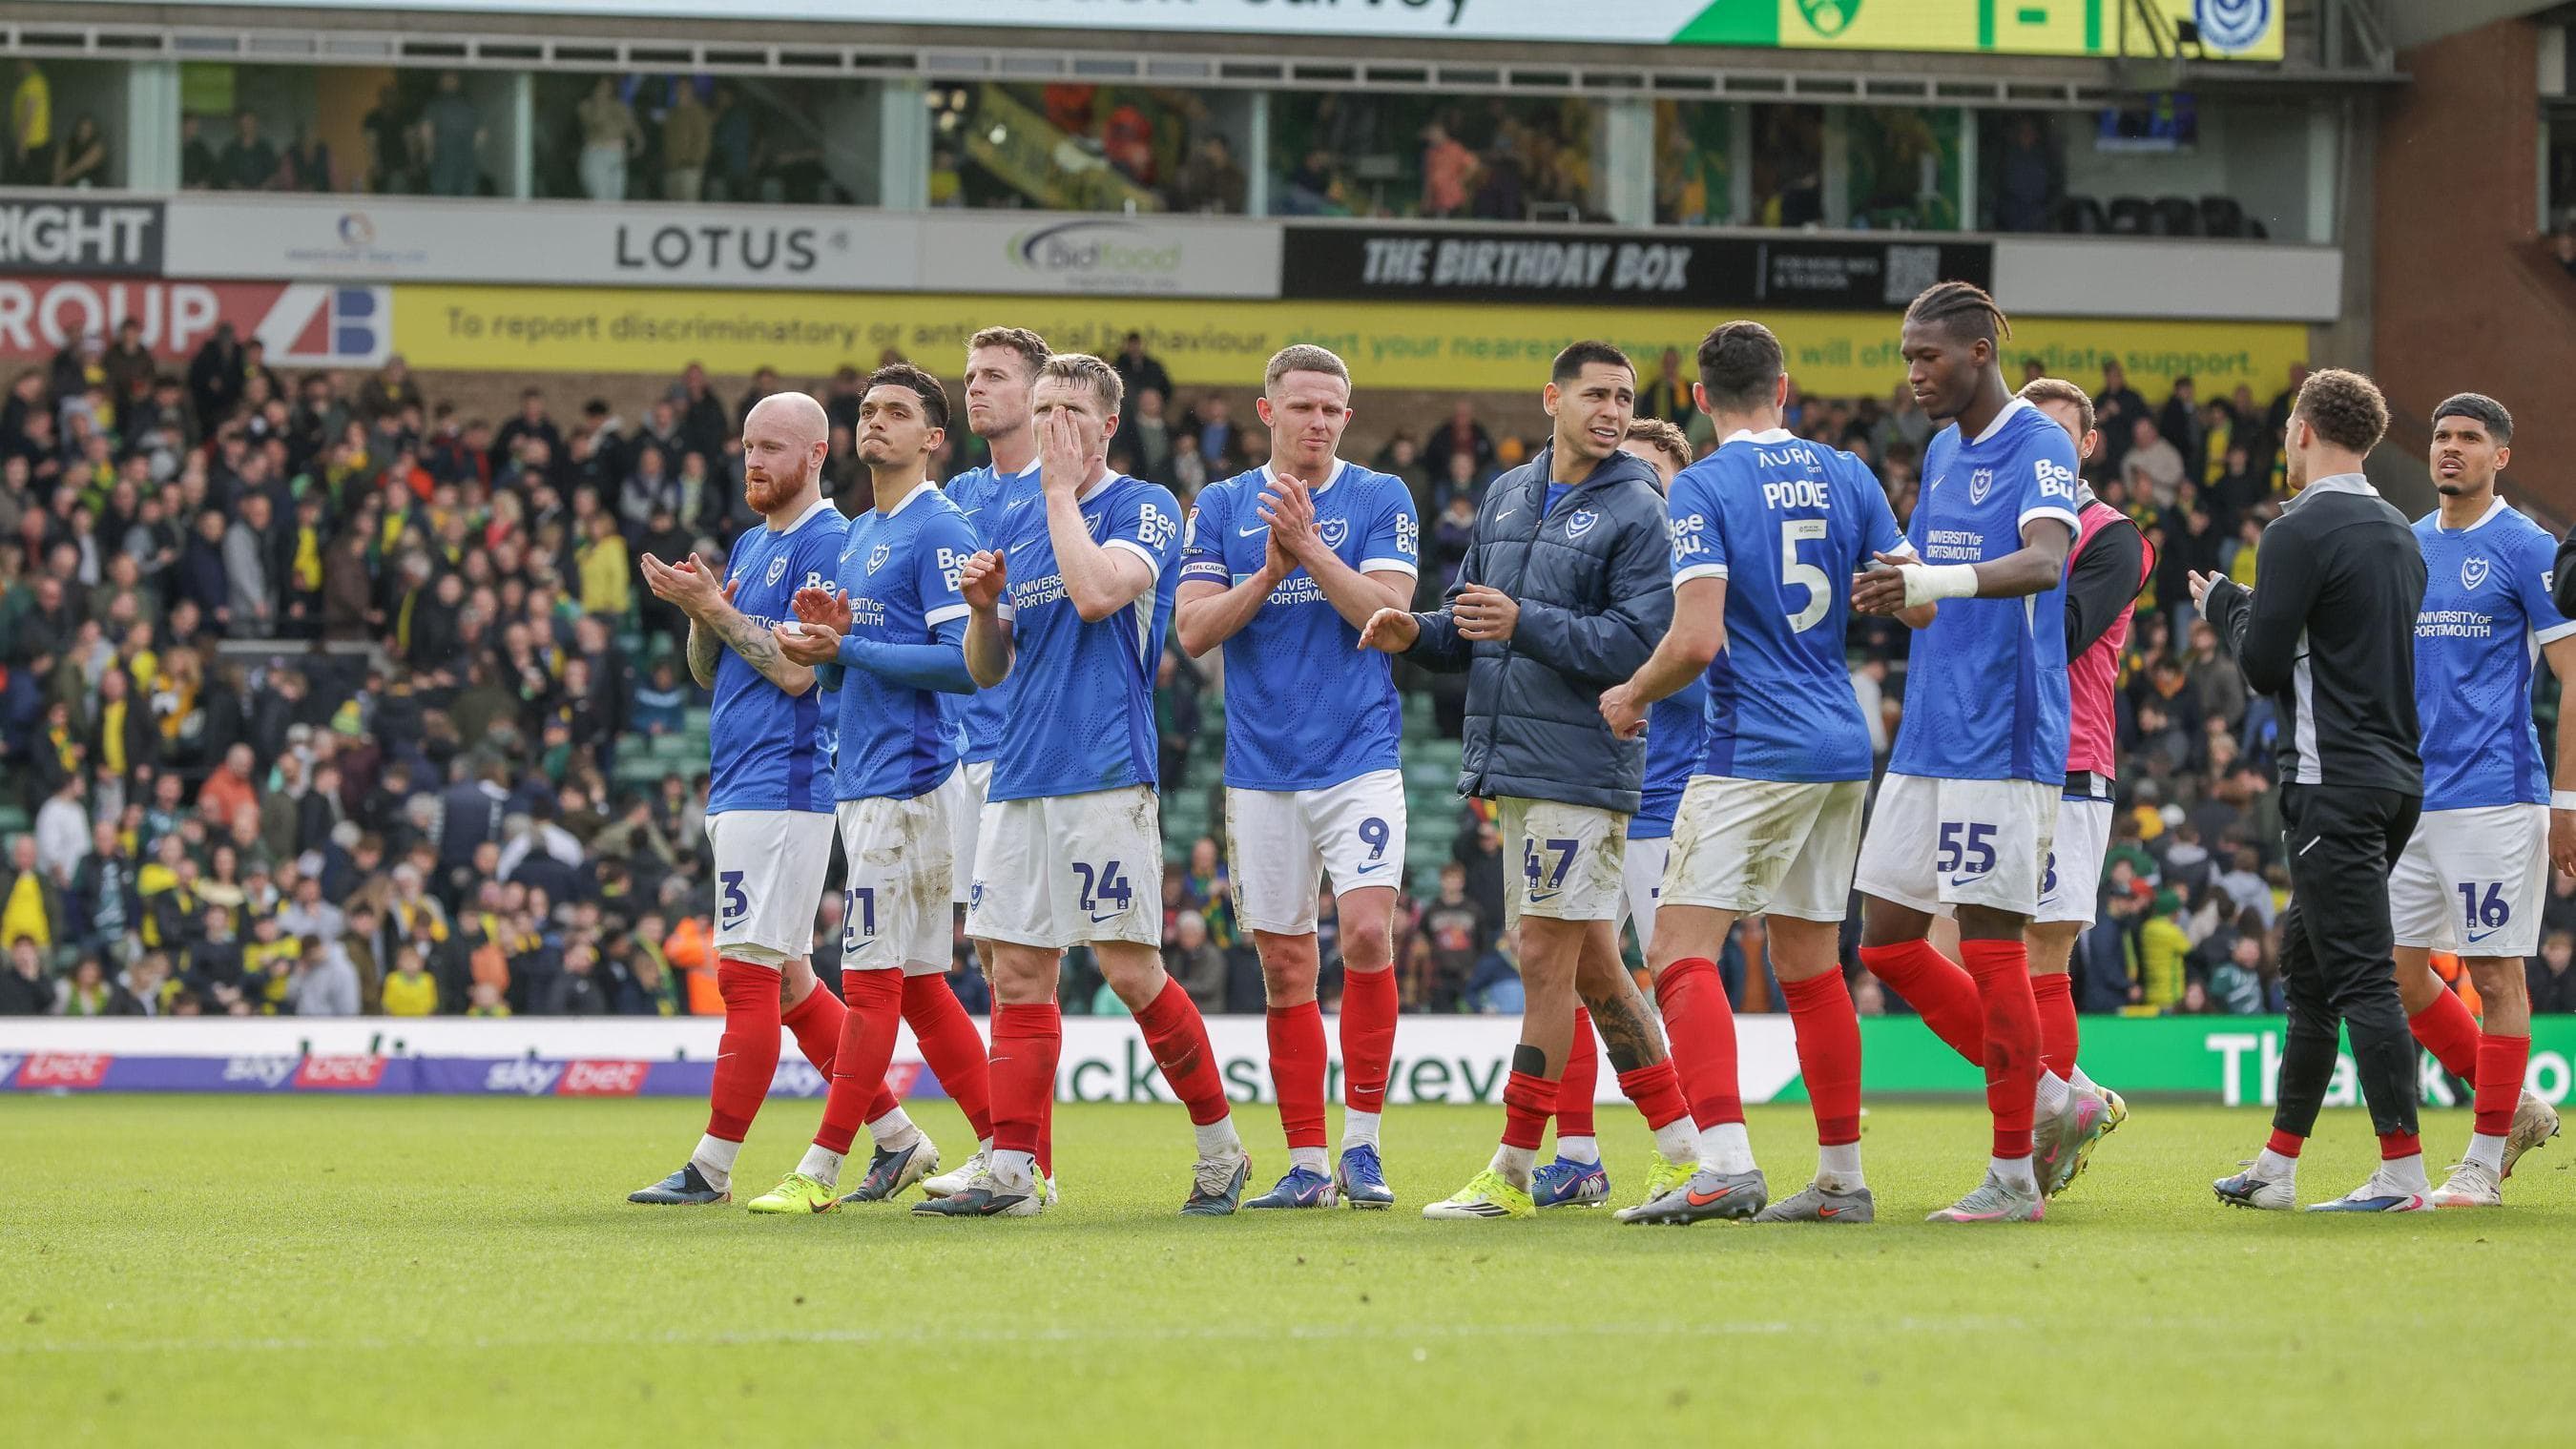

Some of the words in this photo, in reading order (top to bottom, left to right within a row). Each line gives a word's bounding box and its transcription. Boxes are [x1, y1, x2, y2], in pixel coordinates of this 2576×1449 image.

[0, 204, 155, 265] IGHT
[615, 224, 818, 272] LOTUS
[1362, 239, 1429, 284] THE
[1431, 239, 1610, 287] BIRTHDAY
[1612, 244, 1693, 290] BOX
[447, 306, 481, 339] To
[490, 312, 600, 344] report
[610, 310, 859, 350] discriminatory
[869, 323, 904, 348] or
[1370, 335, 1441, 362] your
[1799, 338, 1852, 366] will
[1762, 479, 1830, 510] POOLE
[1139, 503, 1177, 540] Bee
[1015, 573, 1062, 597] UNIVERS
[1781, 519, 1832, 634] 5
[1359, 817, 1389, 859] 9
[1524, 838, 1579, 888] 47
[1938, 821, 1997, 873] 55
[719, 870, 748, 918] 3
[1072, 860, 1132, 911] 24
[2458, 882, 2509, 928] 16
[844, 887, 875, 938] 21
[485, 1061, 563, 1096] sky
[566, 1059, 641, 1091] bet
[2205, 1031, 2456, 1107] Thak
